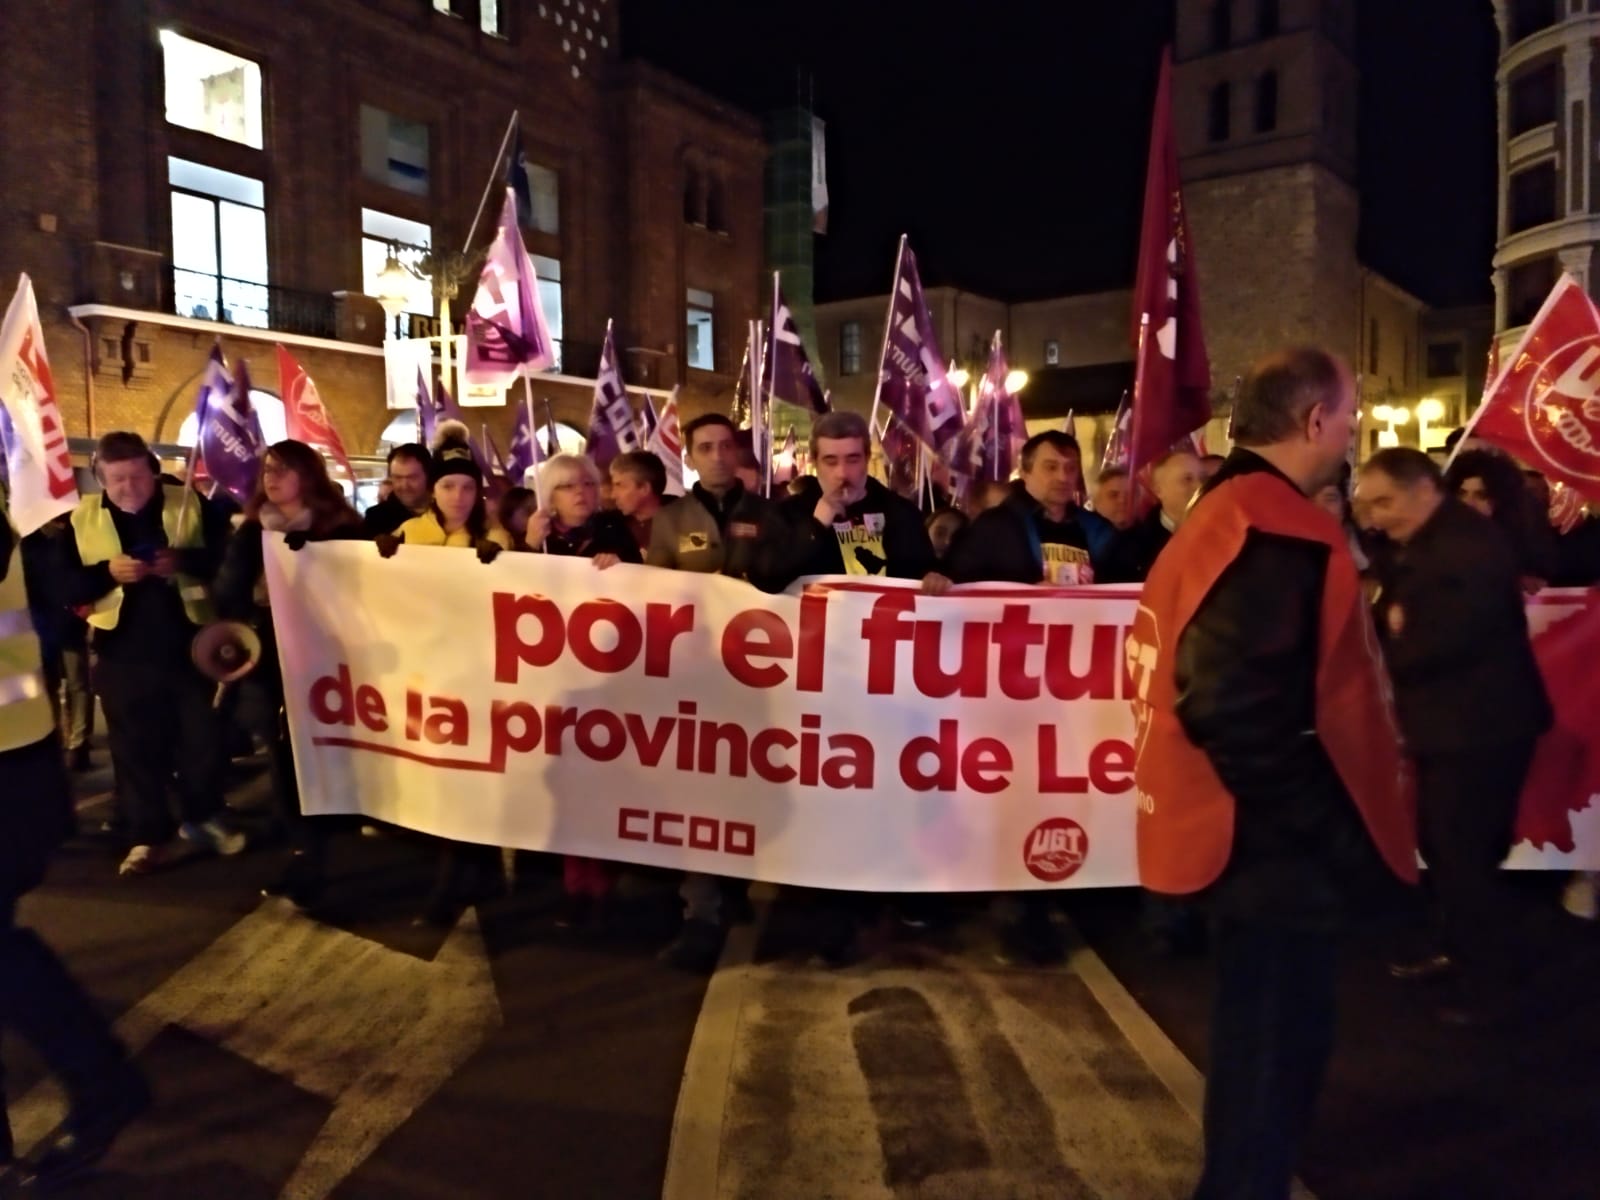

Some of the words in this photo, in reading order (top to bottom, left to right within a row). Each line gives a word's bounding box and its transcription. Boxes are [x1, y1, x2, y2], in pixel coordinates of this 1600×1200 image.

[492, 591, 695, 684] por
[720, 584, 828, 693] el
[308, 663, 389, 733] de
[405, 676, 469, 746] la
[490, 699, 876, 790] provincia
[899, 719, 1013, 793] de
[1038, 724, 1137, 794] Le
[618, 807, 756, 856] CCOO
[1031, 827, 1081, 855] UGT
